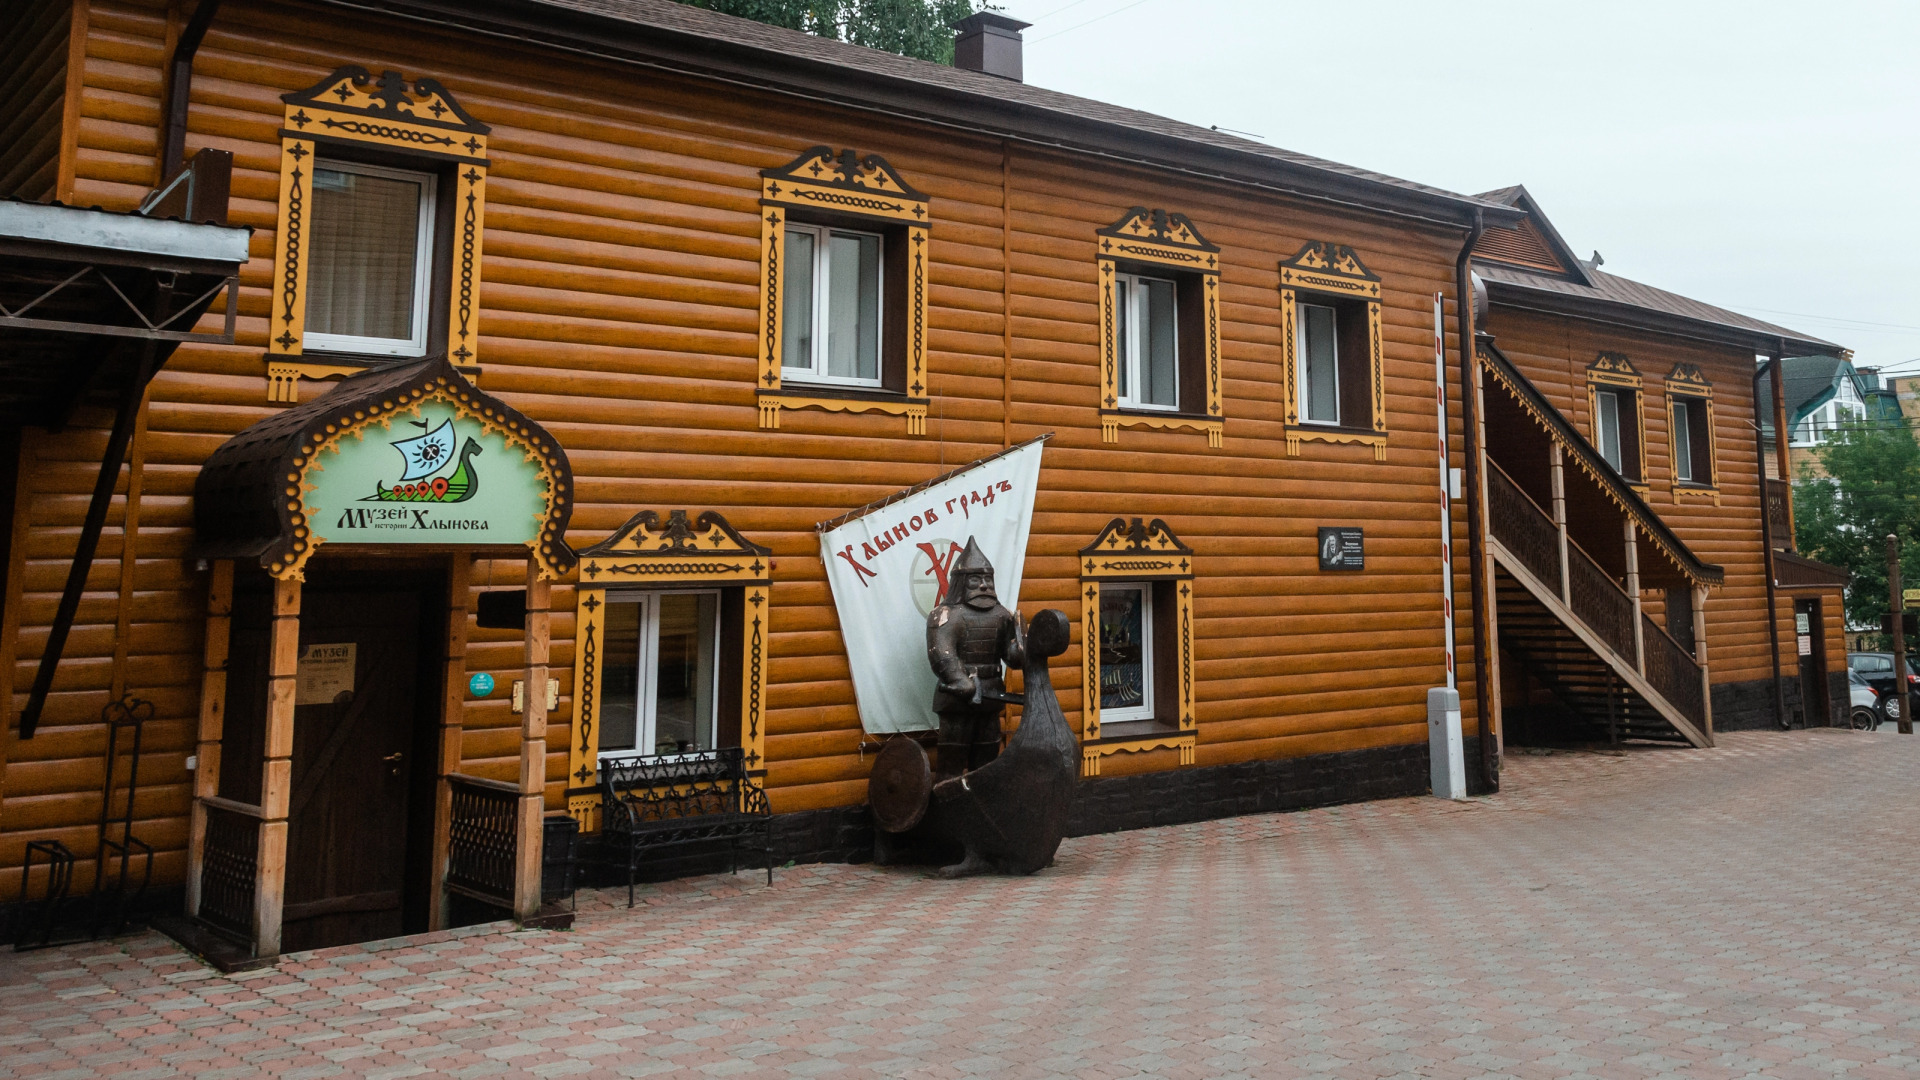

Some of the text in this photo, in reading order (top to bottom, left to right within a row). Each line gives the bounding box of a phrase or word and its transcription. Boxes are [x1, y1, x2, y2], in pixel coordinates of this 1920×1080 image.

[336, 506, 408, 529] Музей
[374, 509, 490, 531] истории Хлынова
[837, 479, 1013, 587] Хлынов градъ
